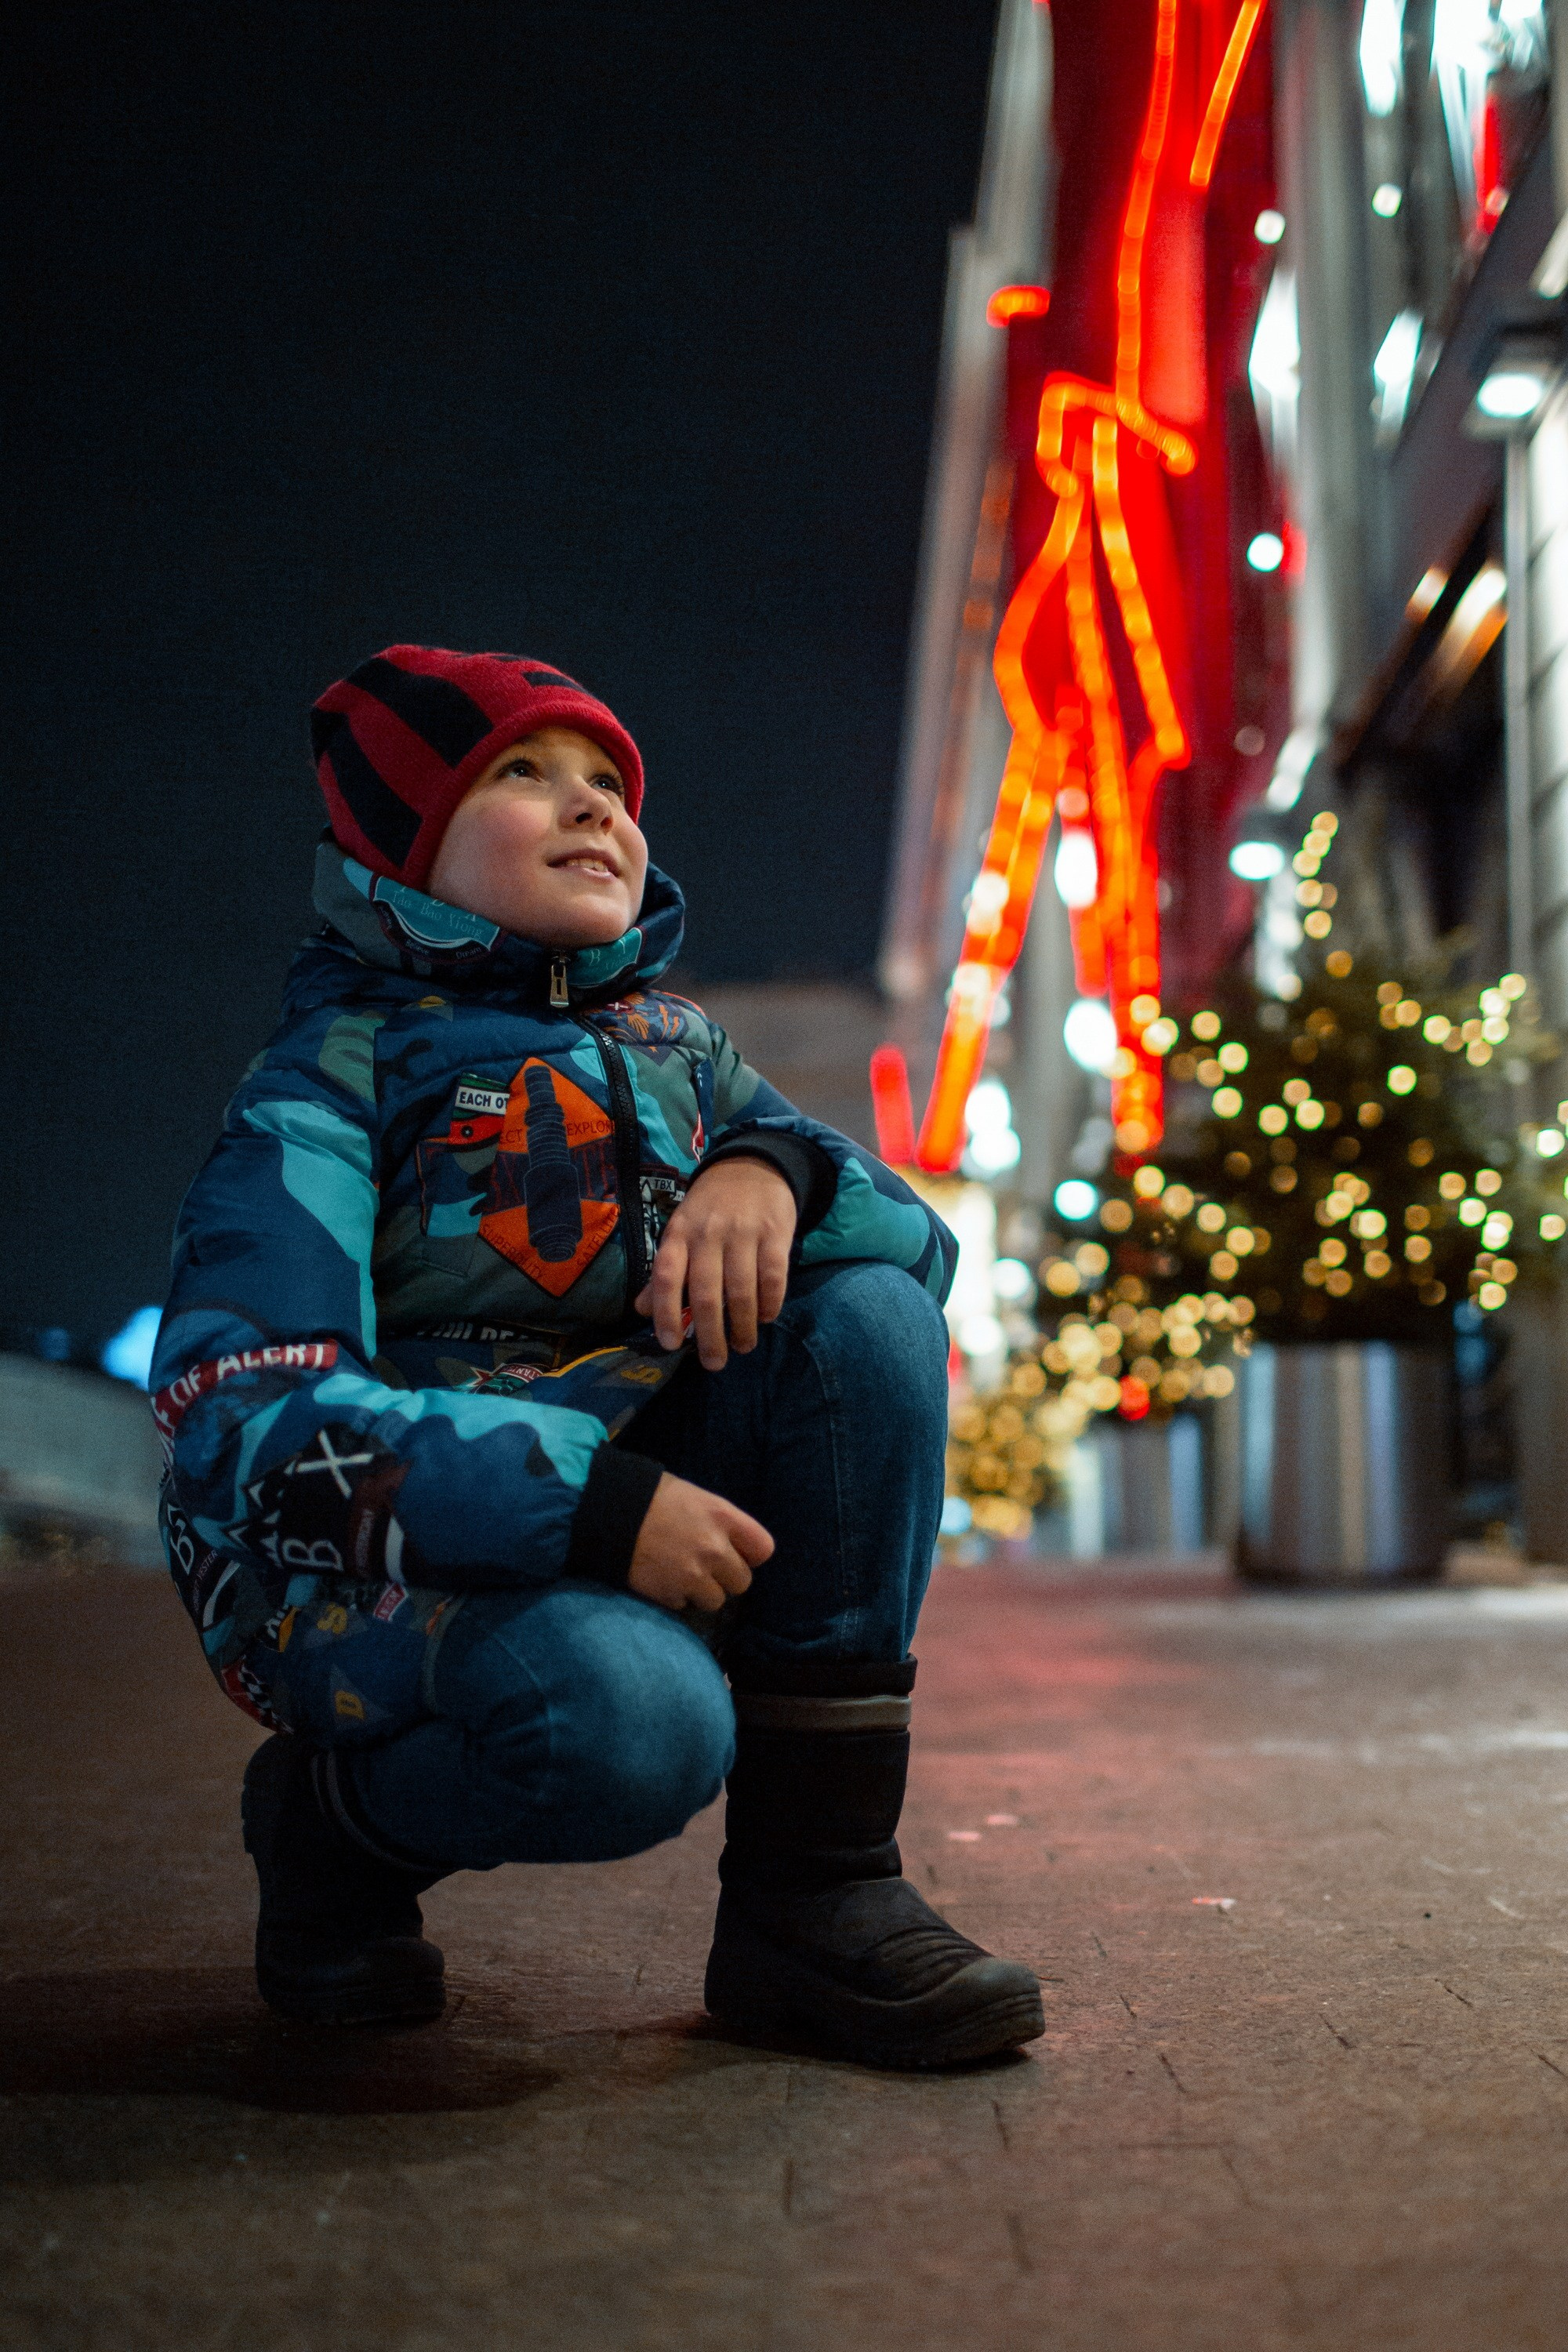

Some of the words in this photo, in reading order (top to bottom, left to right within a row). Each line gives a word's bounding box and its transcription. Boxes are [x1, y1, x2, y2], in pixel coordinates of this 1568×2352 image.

[420, 902, 442, 920] Bao
[459, 1092, 492, 1107] EACH
[655, 1179, 673, 1190] TBX
[216, 1342, 325, 1381] ALERT
